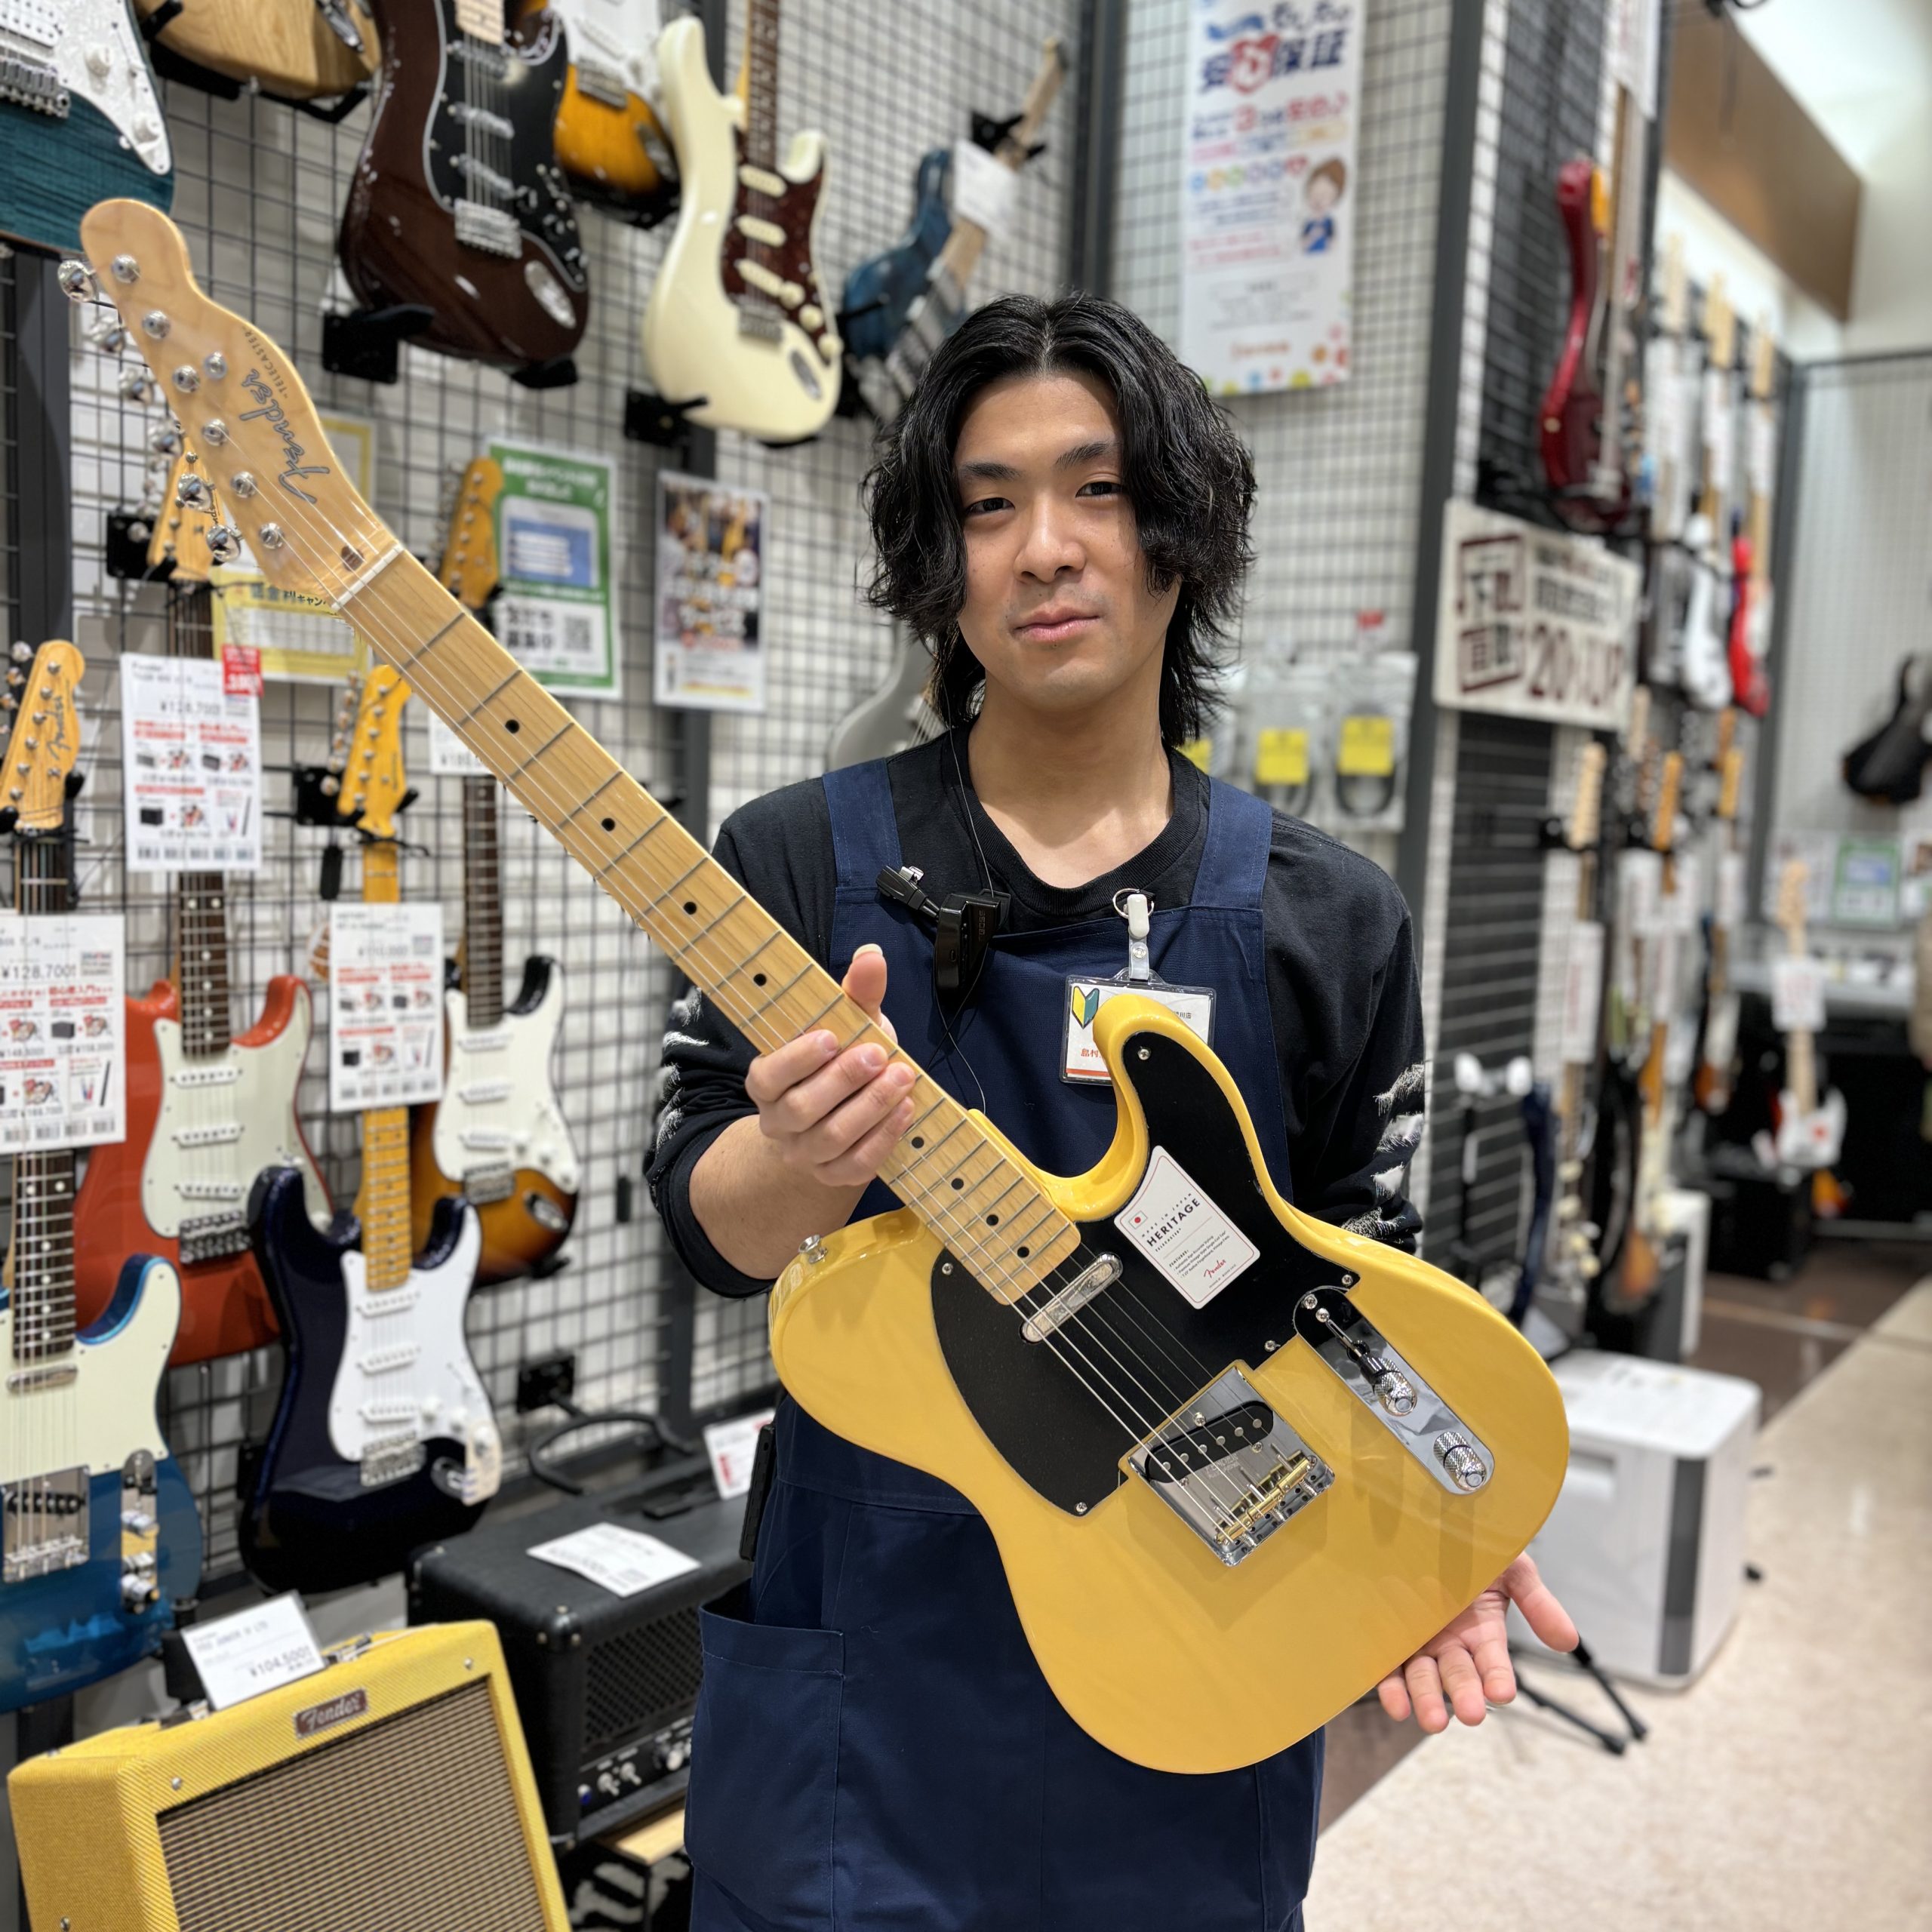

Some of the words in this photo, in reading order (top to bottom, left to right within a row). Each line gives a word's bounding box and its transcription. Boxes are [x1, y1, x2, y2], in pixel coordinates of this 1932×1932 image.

[239, 368, 330, 503] Fender
[45, 697, 72, 761] Fender
[1081, 1048, 1103, 1058] 島村
[1141, 1222, 1158, 1238] MADE
[1172, 1192, 1192, 1211] JAPAN
[1146, 1198, 1201, 1247] HERITAGE
[1203, 1259, 1226, 1278] Fender
[301, 1693, 361, 1734] Fender
